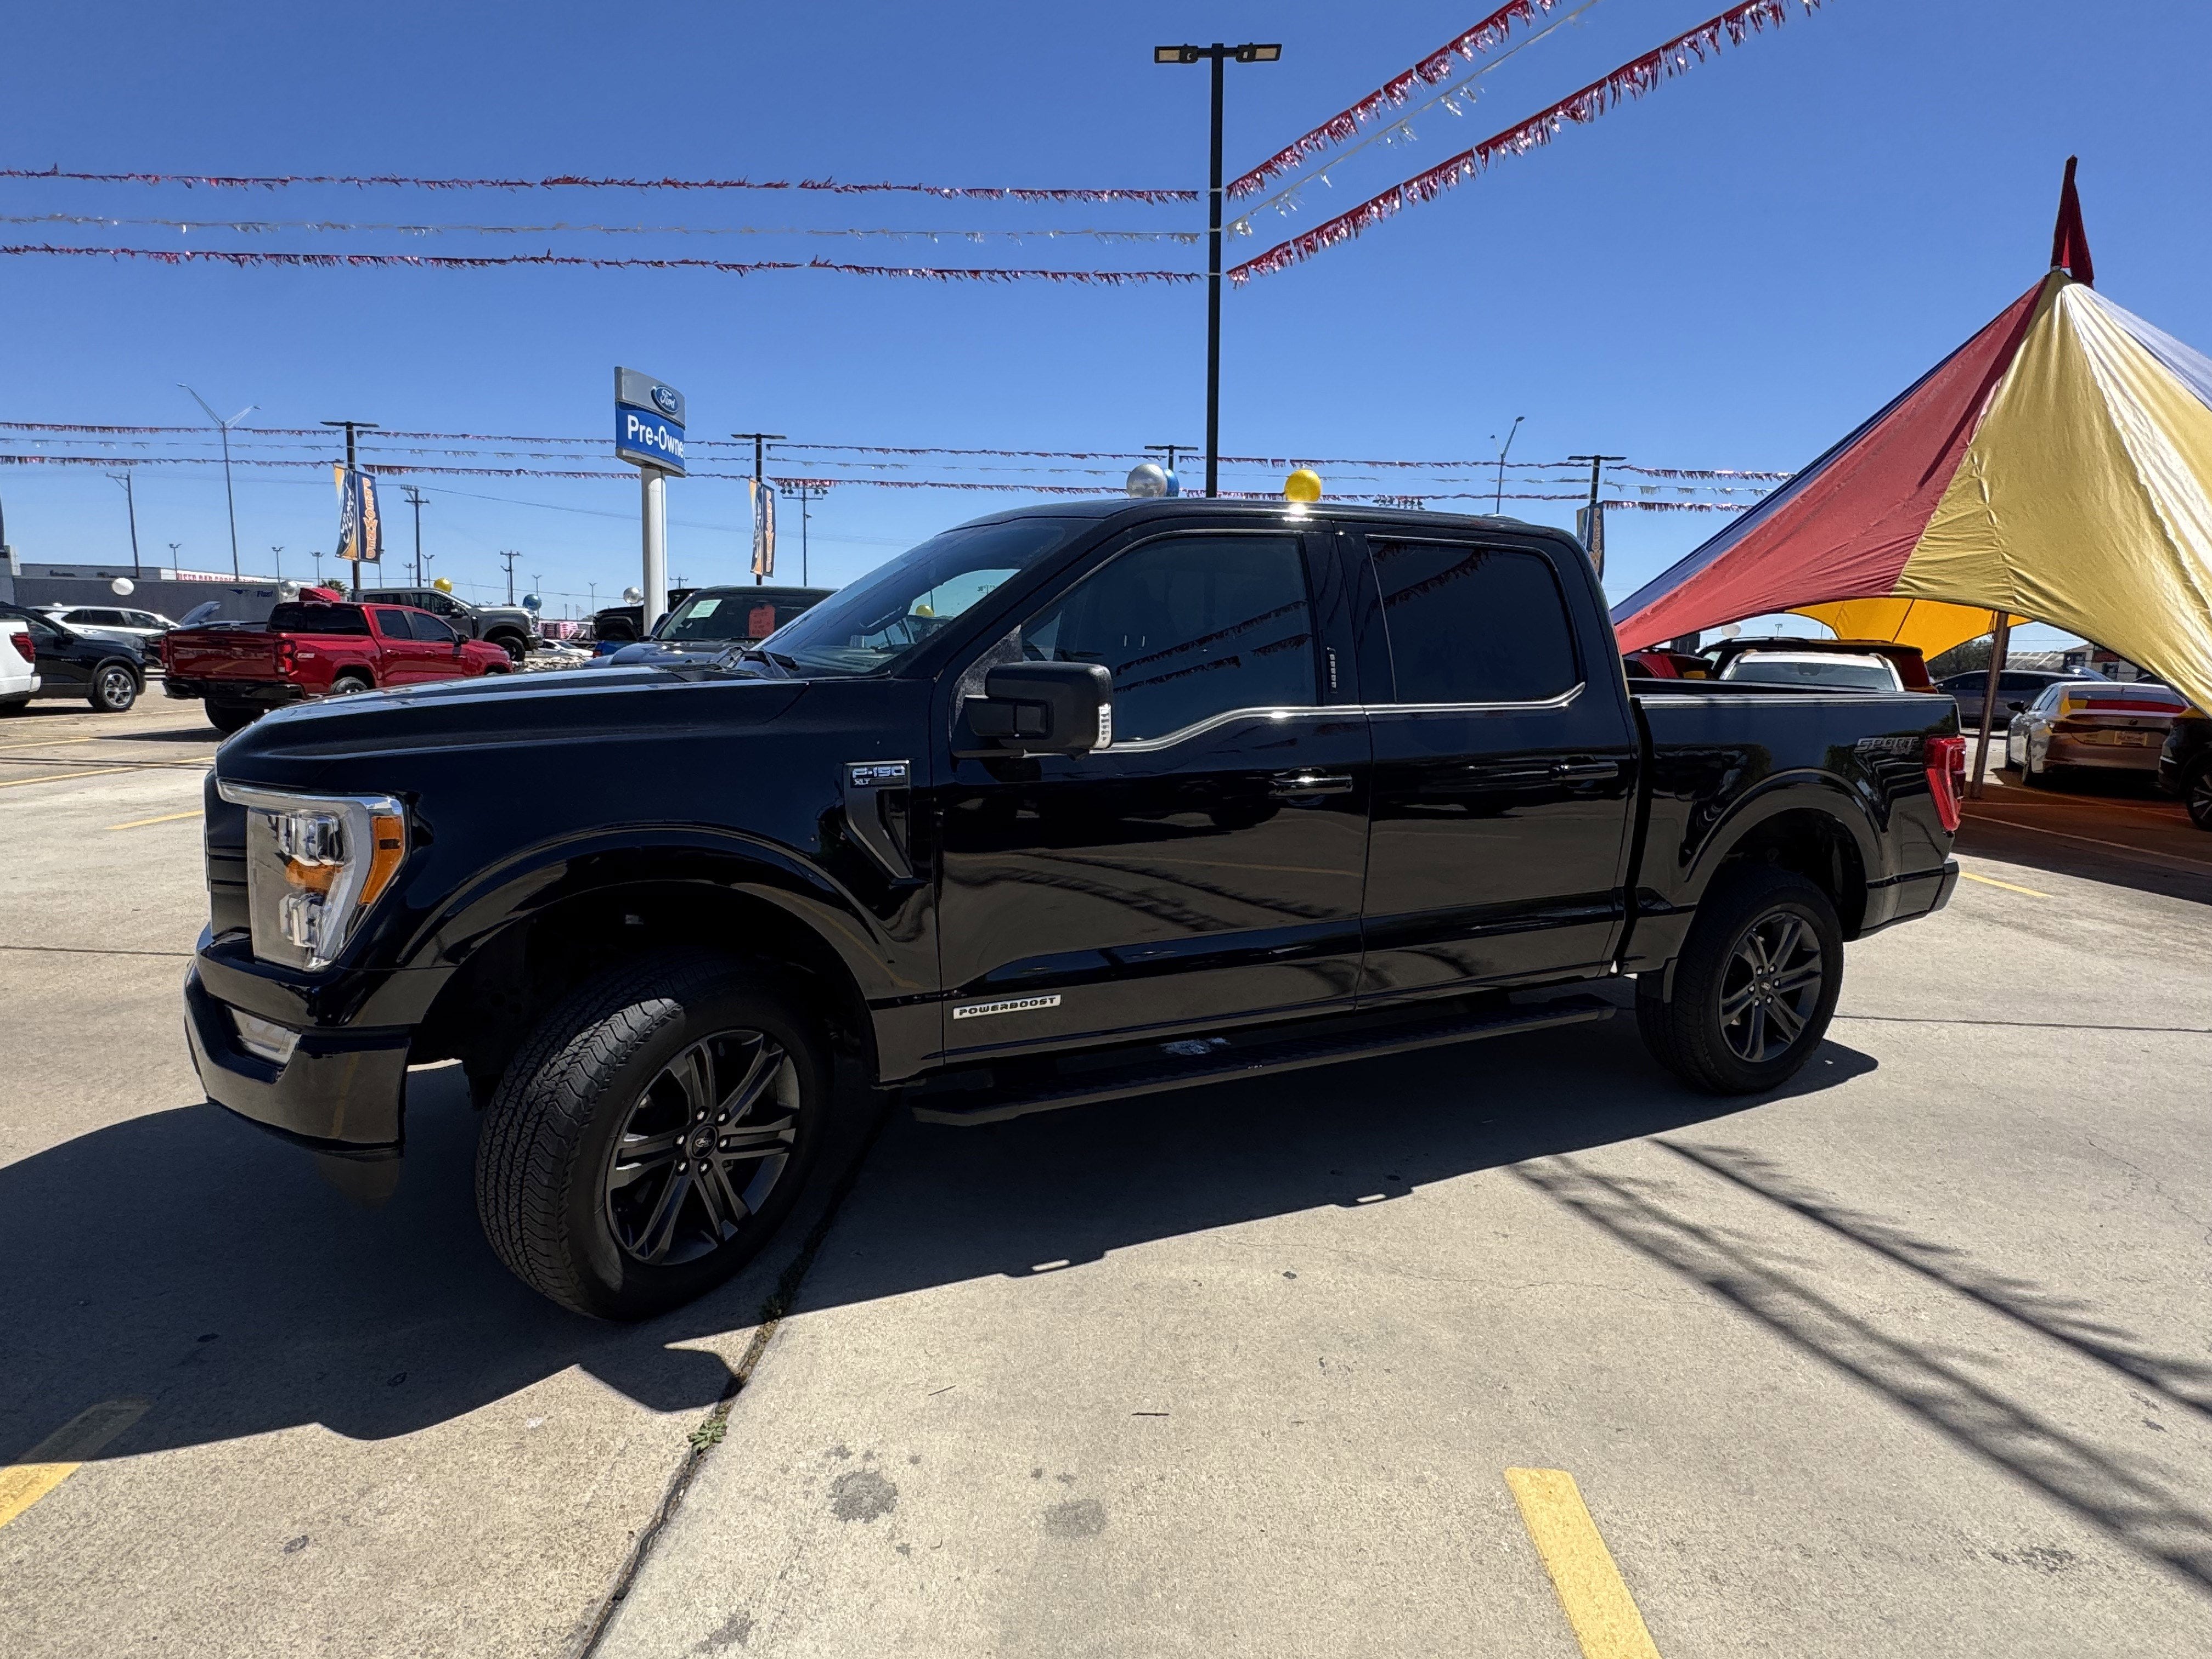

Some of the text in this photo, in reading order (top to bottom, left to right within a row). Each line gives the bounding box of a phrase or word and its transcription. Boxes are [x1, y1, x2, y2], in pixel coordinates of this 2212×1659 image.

[660, 388, 676, 409] Ford
[628, 415, 684, 459] Pre-Owne
[1854, 736, 1919, 753] SPORT
[852, 765, 905, 778] F-150
[959, 997, 1057, 1016] POWERBOOST
